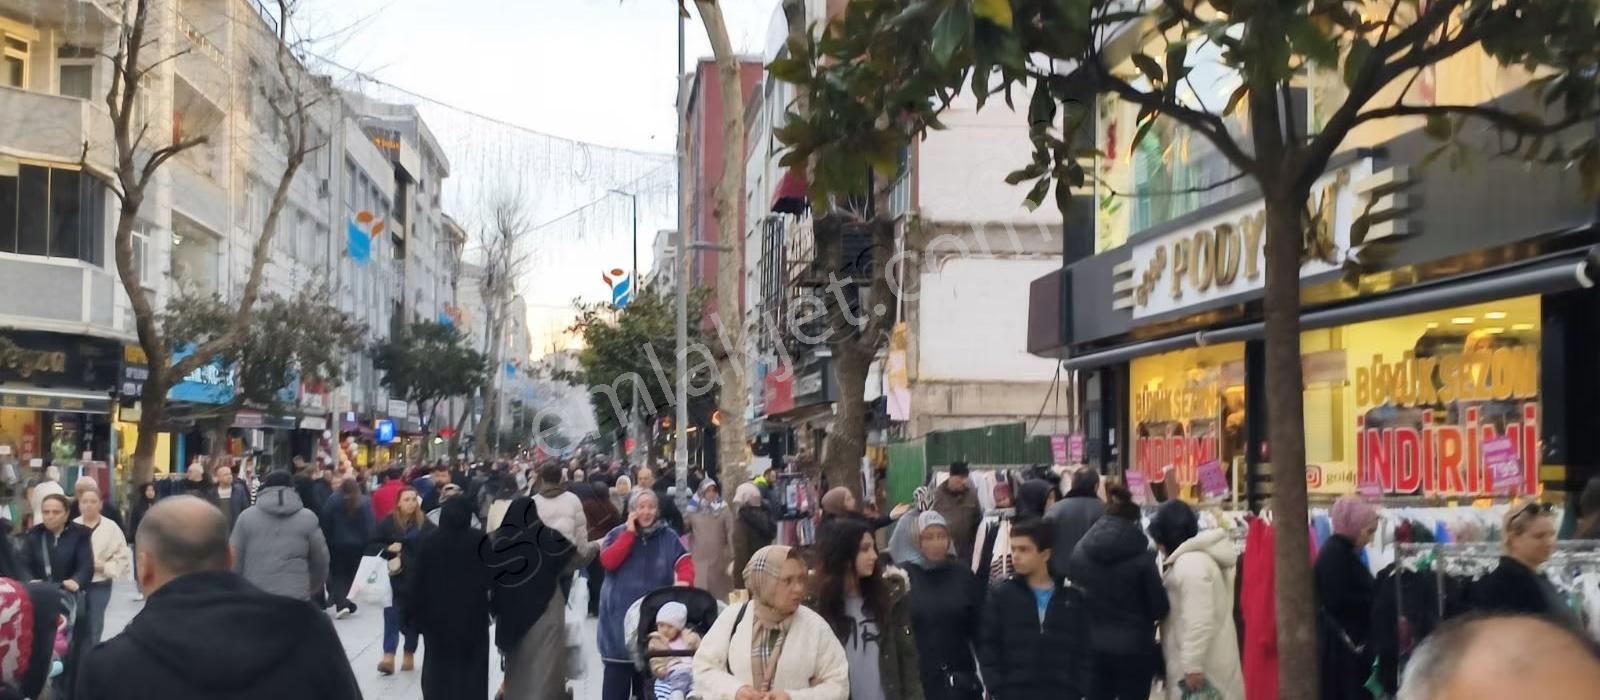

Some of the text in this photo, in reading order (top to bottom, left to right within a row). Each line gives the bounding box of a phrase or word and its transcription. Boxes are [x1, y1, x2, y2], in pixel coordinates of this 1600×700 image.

[1170, 168, 1348, 300] PODYM
[1356, 345, 1538, 407] BÜYÜK SEZON
